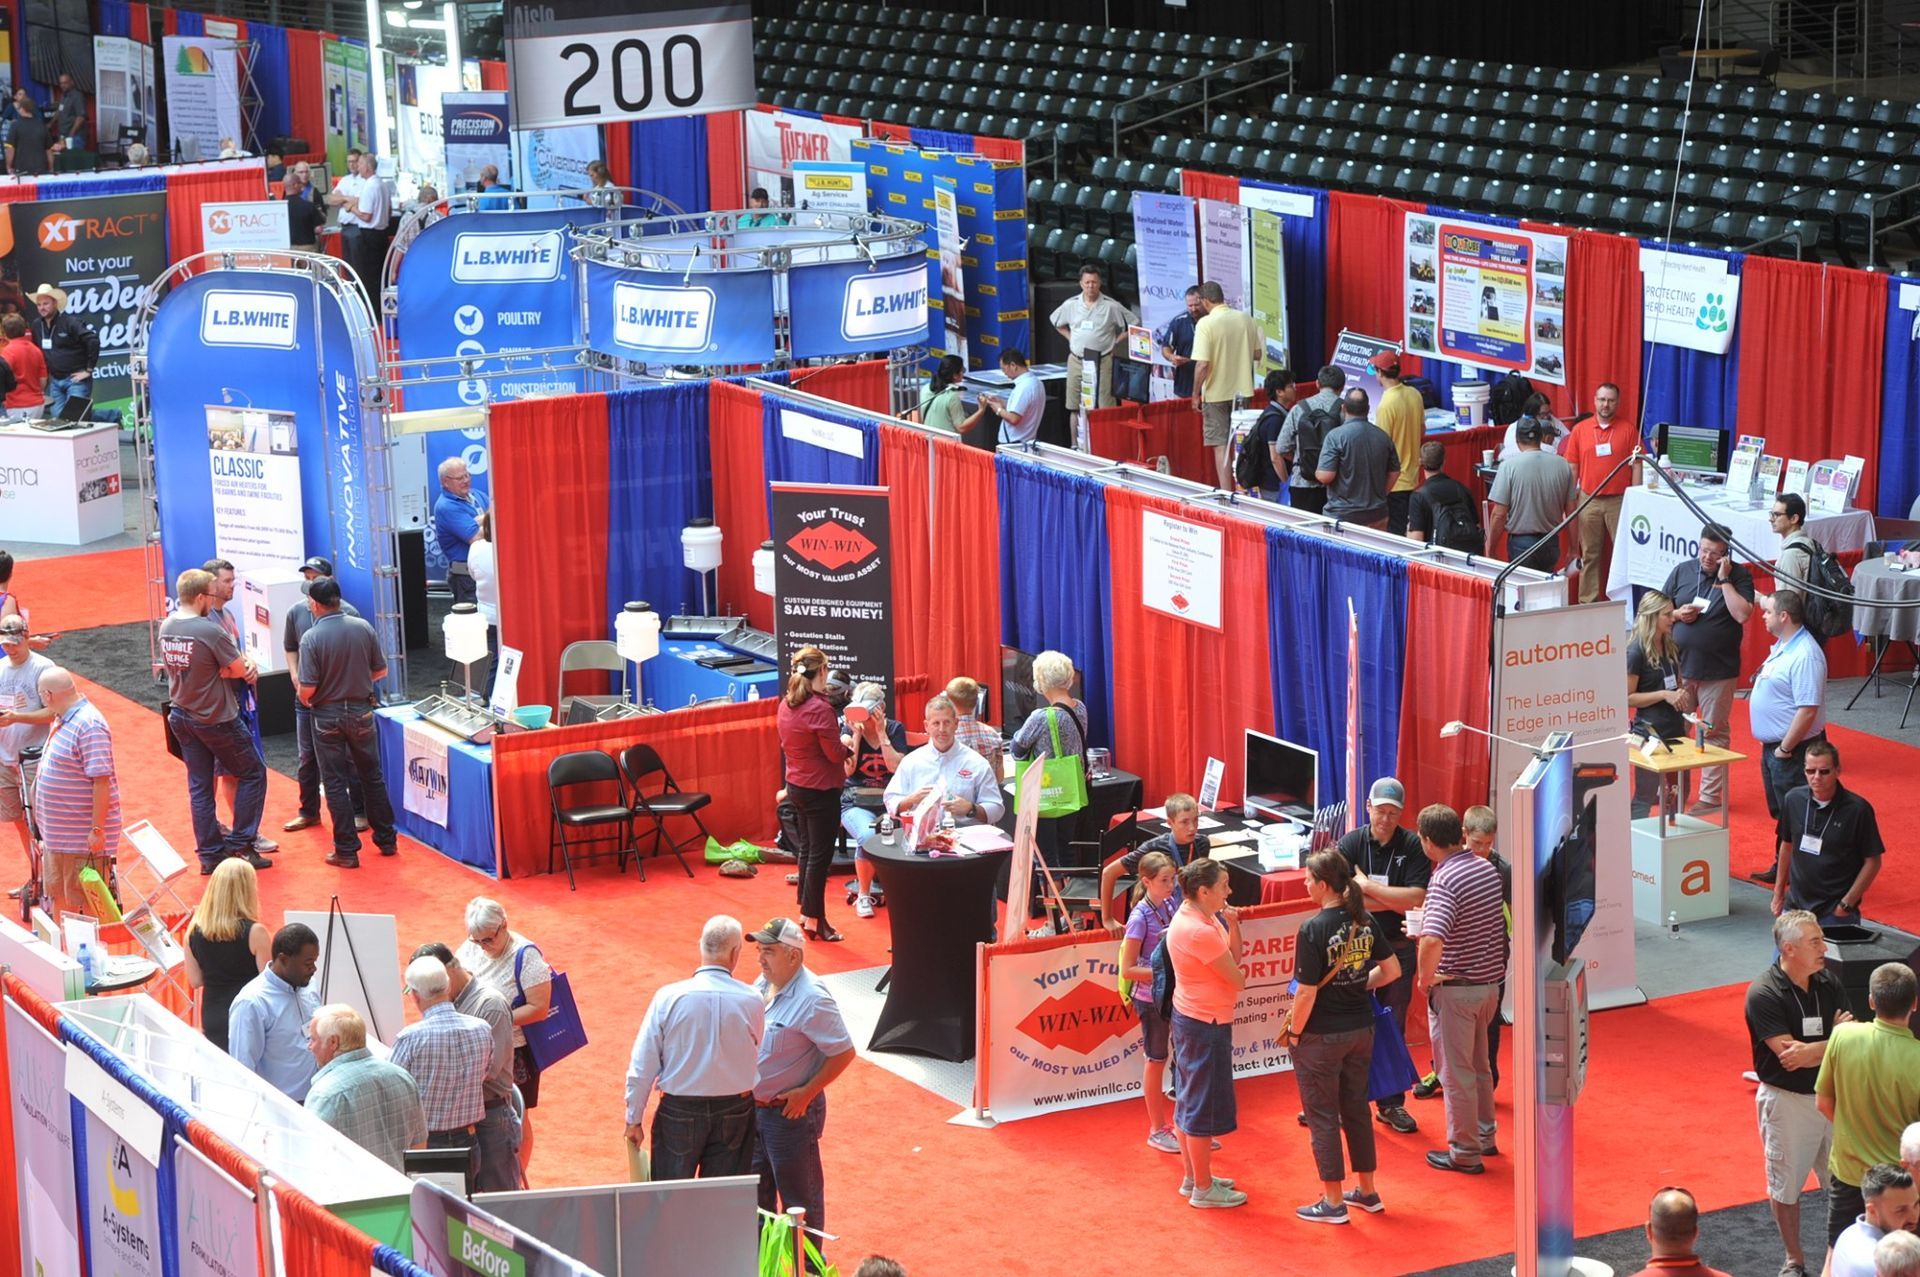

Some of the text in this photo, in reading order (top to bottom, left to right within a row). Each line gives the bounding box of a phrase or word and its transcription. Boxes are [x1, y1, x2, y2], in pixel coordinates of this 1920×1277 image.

[560, 34, 703, 117] 200
[451, 118, 495, 129] PRECISION
[65, 256, 133, 273] Not your
[65, 275, 158, 314] arden
[1646, 286, 1696, 303] PROTECTING
[497, 311, 542, 326] POULTRY
[1645, 302, 1695, 318] HERD HEALTH
[1337, 352, 1351, 361] HERD
[1340, 341, 1373, 356] PROTECTING
[501, 382, 577, 396] CONSTRUCTION
[345, 377, 361, 479] solutions
[213, 455, 264, 479] CLASSIC
[335, 370, 357, 568] INNOVATIVE
[797, 507, 866, 528] Your Trust
[799, 537, 863, 554] WIN-WIN
[1660, 525, 1699, 559] inno
[782, 553, 882, 583] our MOST VALUED ASSET
[783, 597, 883, 609] CUSTOM DESIGNED EQUIPMENT
[784, 604, 883, 620] SAVES MONEY!
[789, 631, 824, 640] Gestation
[819, 643, 849, 652] Stations
[827, 662, 851, 670] Crates
[859, 674, 885, 682] Coated
[1506, 688, 1595, 711] The Leading
[1506, 705, 1616, 733] Edge in Health
[1681, 859, 1711, 896] a
[1241, 935, 1294, 958] CARE
[1033, 964, 1080, 990] Your
[1038, 1004, 1133, 1034] WIN-WIN
[1232, 1044, 1246, 1058] ay
[1249, 1041, 1259, 1054] &
[1009, 1046, 1030, 1063] our
[1031, 1058, 1069, 1076] MOST
[1072, 1054, 1121, 1076] VALUED
[1263, 1054, 1293, 1070] (217)
[1033, 1081, 1142, 1106] www.winwinllc.co
[118, 1144, 132, 1178] A
[103, 1205, 150, 1261] A-Systems
[462, 1231, 510, 1277] Before
